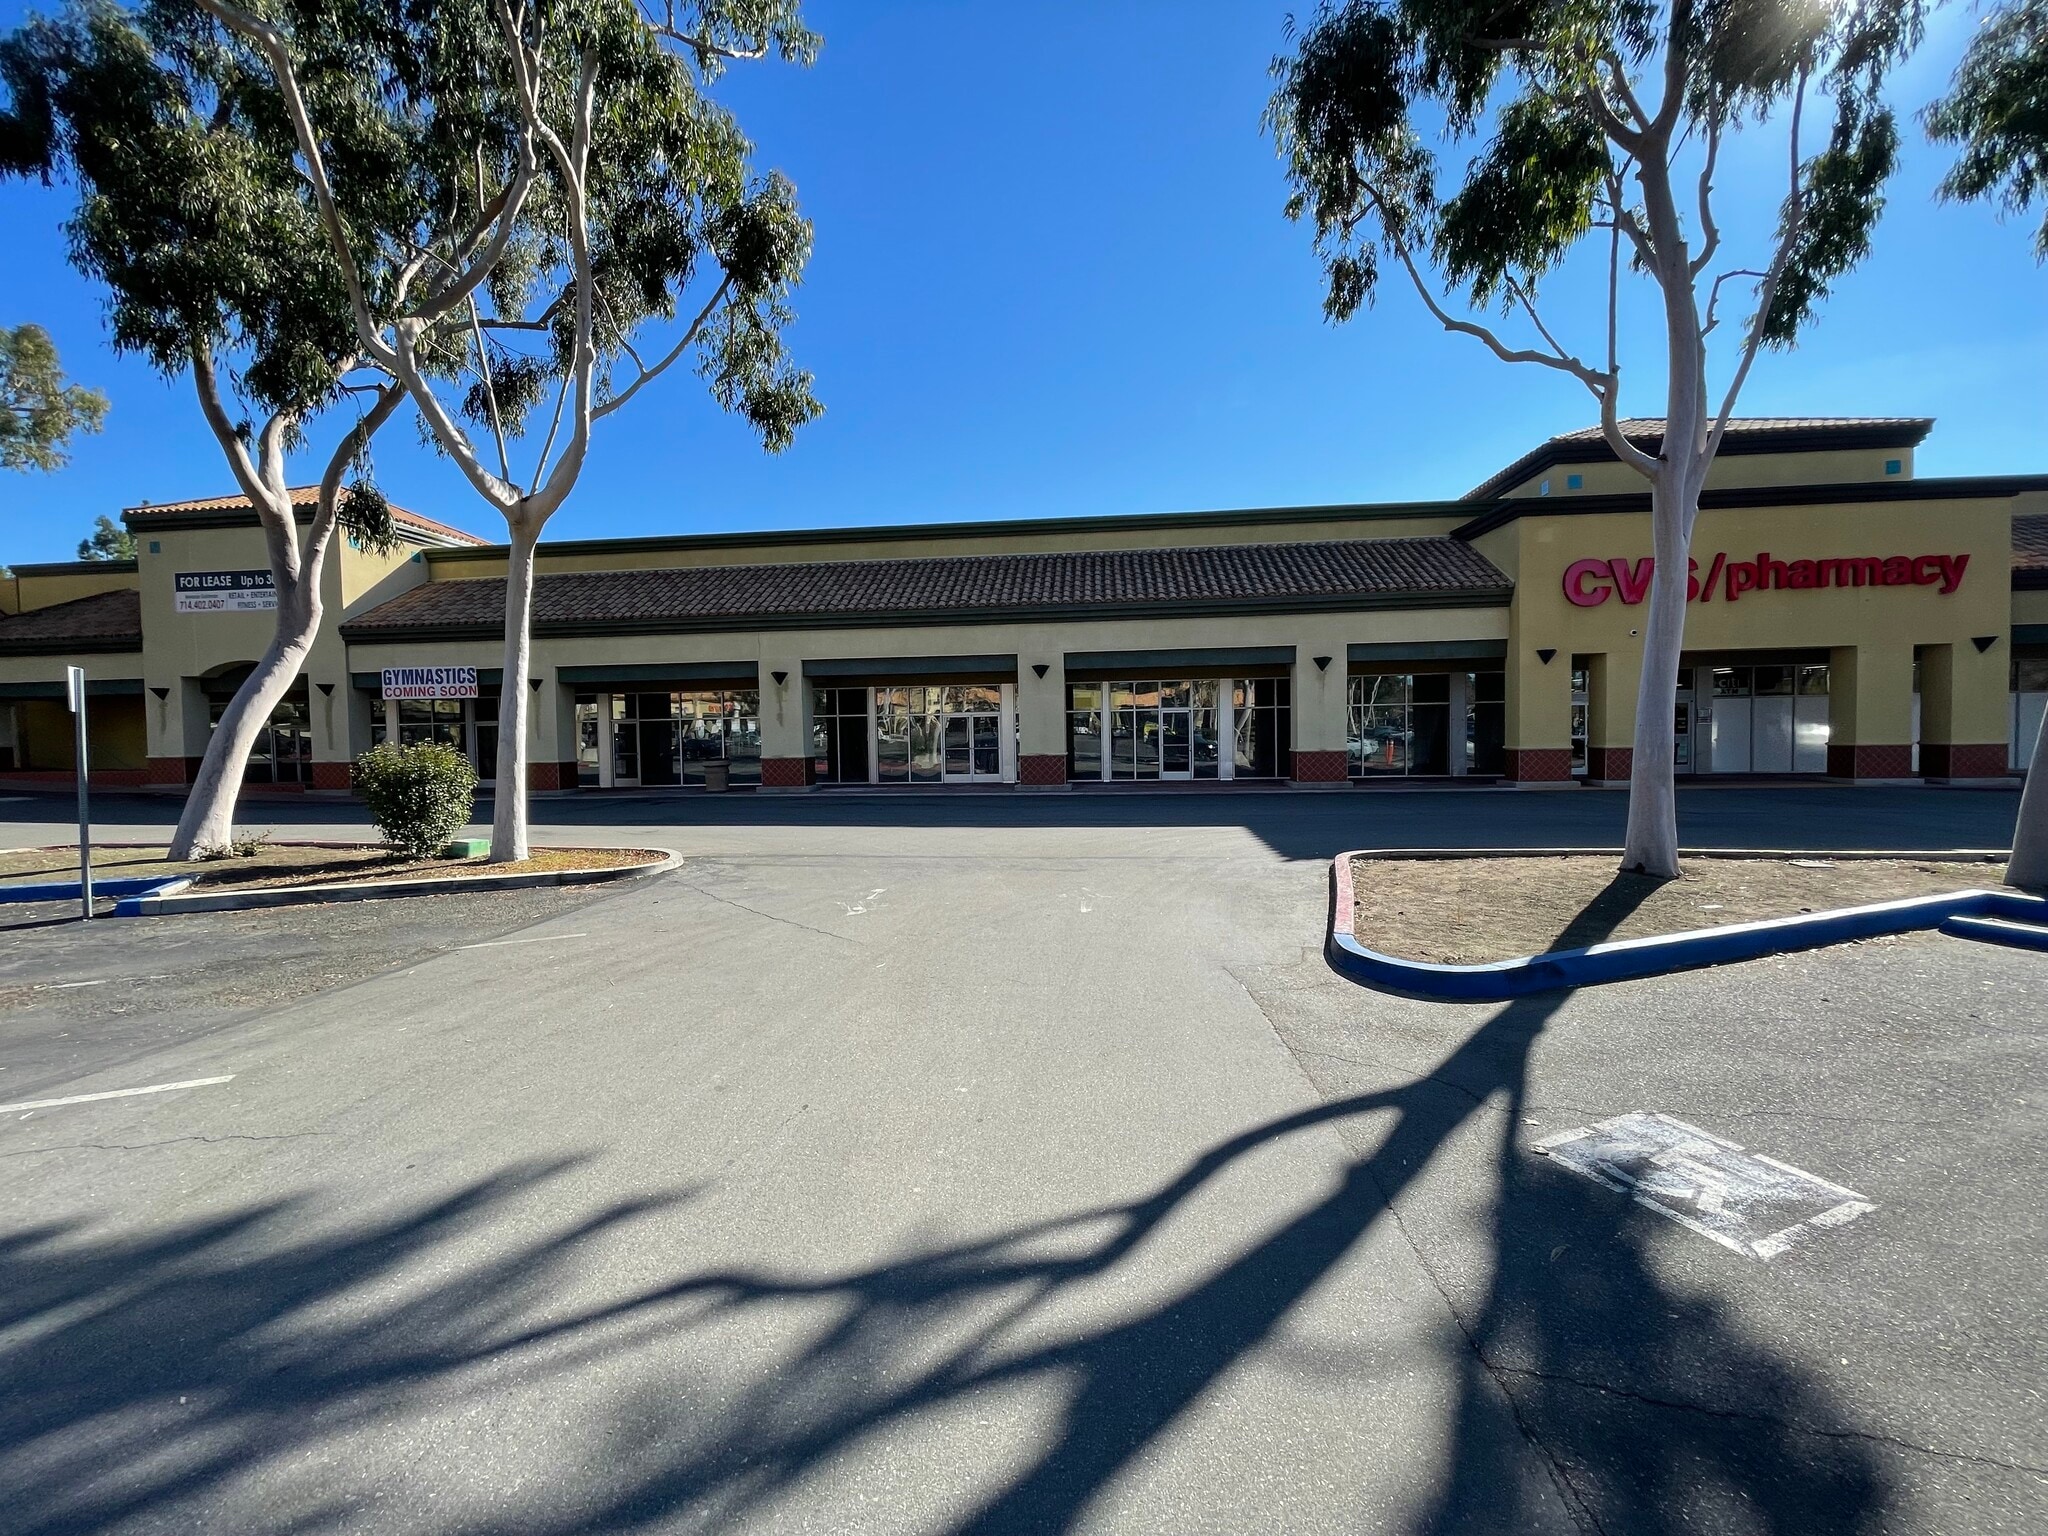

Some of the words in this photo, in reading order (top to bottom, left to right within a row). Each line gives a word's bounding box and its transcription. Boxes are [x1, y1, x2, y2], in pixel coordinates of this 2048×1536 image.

[180, 576, 200, 587] FOR
[202, 575, 231, 586] LEASE
[241, 575, 253, 587] Up
[255, 574, 264, 585] to
[383, 667, 476, 686] GYMNASTICS
[1718, 677, 1739, 687] citi
[384, 686, 435, 698] COMING
[440, 685, 477, 697] SOON
